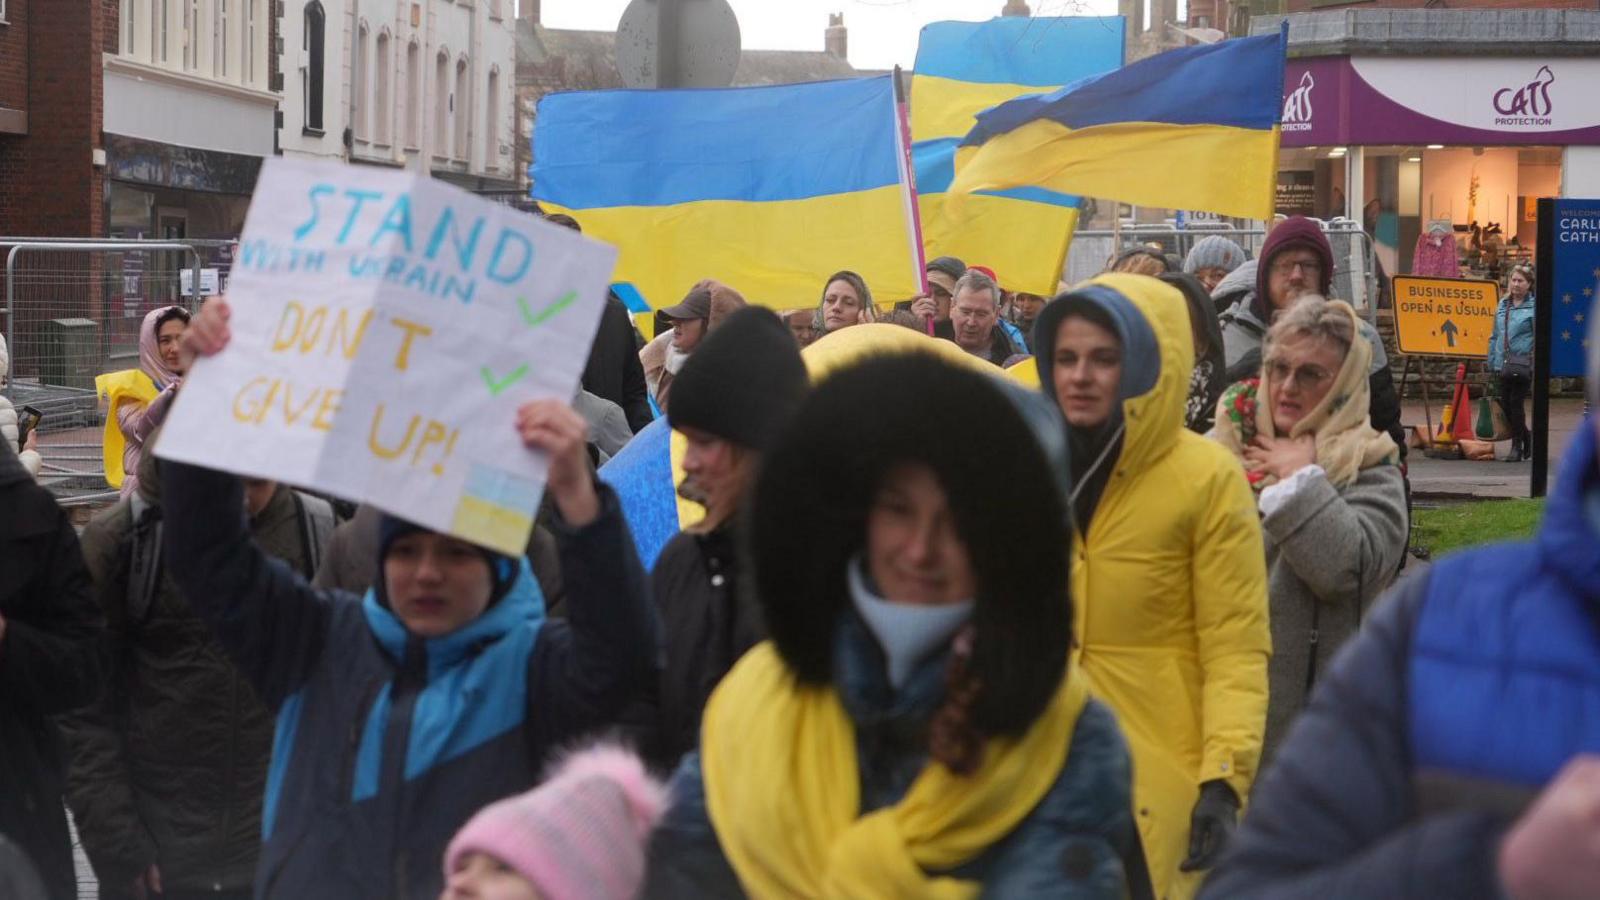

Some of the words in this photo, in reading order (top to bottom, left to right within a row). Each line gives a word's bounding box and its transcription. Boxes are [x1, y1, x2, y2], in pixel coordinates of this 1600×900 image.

[1282, 71, 1314, 122] ATS
[1493, 65, 1555, 116] CATS
[1281, 123, 1312, 131] OTECTION
[1495, 118, 1552, 126] PROTECTION
[294, 183, 533, 285] STAND
[241, 238, 327, 273] WITH
[1401, 302, 1432, 313] OPEN
[1437, 304, 1452, 315] AS
[1456, 305, 1494, 317] USUAL
[1409, 286, 1483, 300] BUSINESSES
[232, 376, 347, 432] GIVE
[369, 402, 460, 477] UP!
